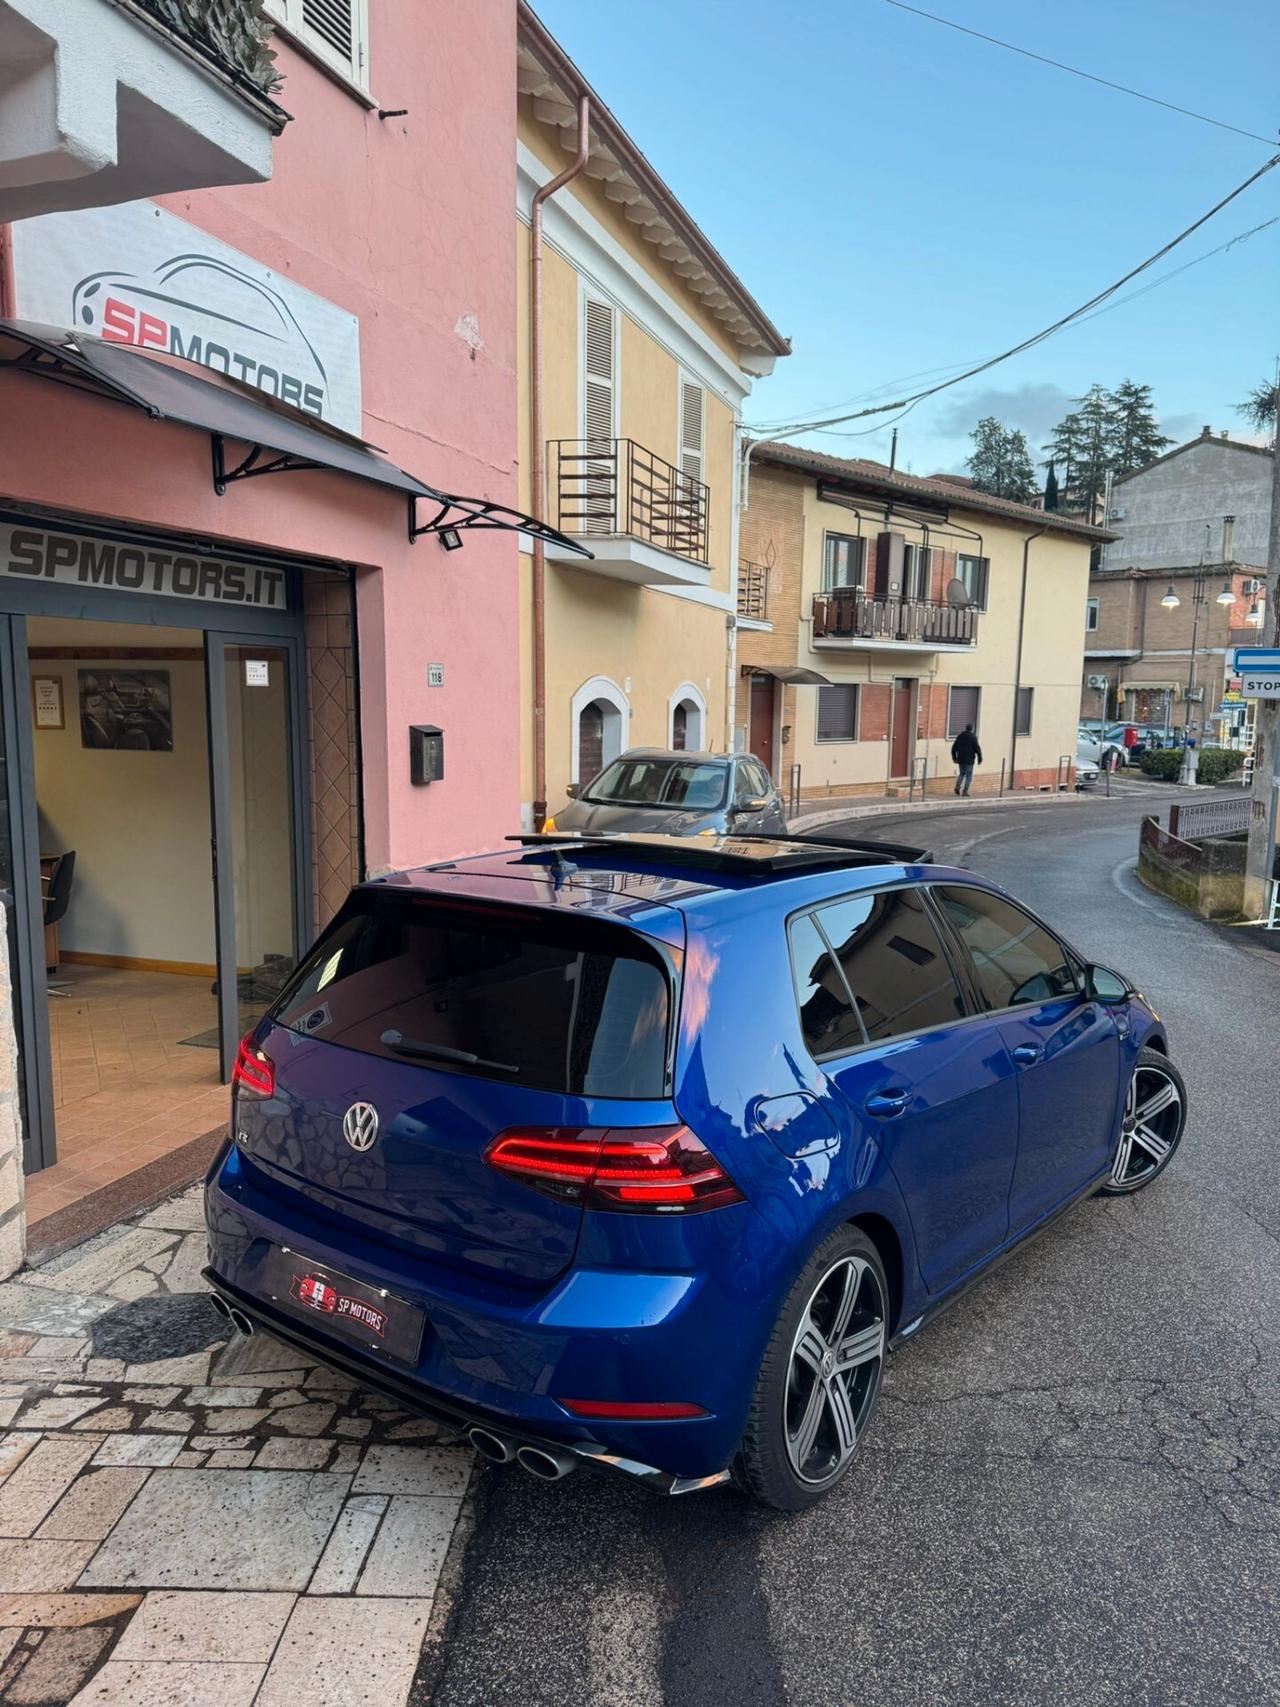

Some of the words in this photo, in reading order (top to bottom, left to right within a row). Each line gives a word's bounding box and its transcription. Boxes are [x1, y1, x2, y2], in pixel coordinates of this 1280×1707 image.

[8, 530, 282, 605] SPMOTORS.IT
[337, 1298, 350, 1313] SP
[349, 1301, 383, 1330] MOTORS
